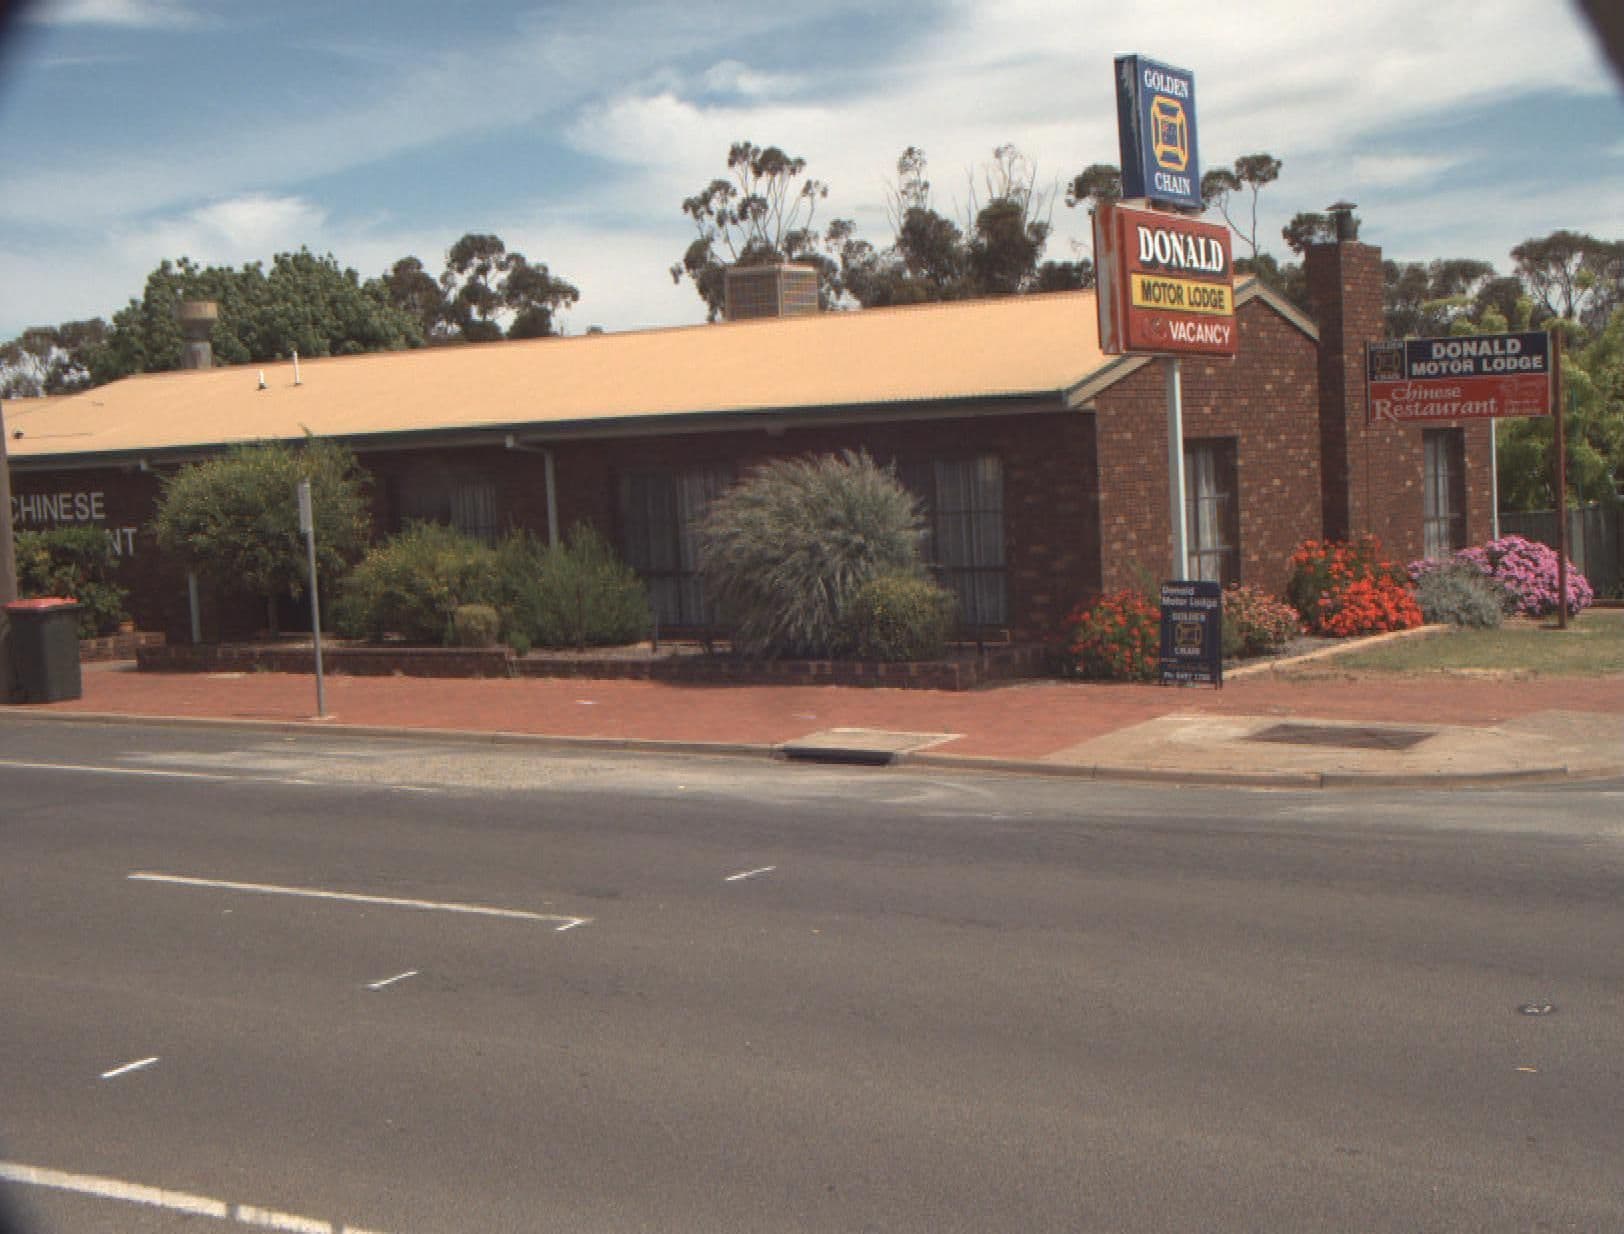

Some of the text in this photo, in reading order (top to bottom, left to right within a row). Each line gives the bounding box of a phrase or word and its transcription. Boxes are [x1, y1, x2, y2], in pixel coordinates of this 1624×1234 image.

[1144, 69, 1189, 97] GOLDEN
[1154, 172, 1190, 195] CHAIN
[1137, 226, 1224, 272] DONALD
[1141, 280, 1225, 310] MOTOR LODGE
[1169, 320, 1231, 345] VACANCY
[1432, 338, 1522, 360] DONALD
[1411, 355, 1544, 376] MOTOR LODGE
[1391, 382, 1462, 401] Chinese
[1375, 398, 1498, 423] Restaurant
